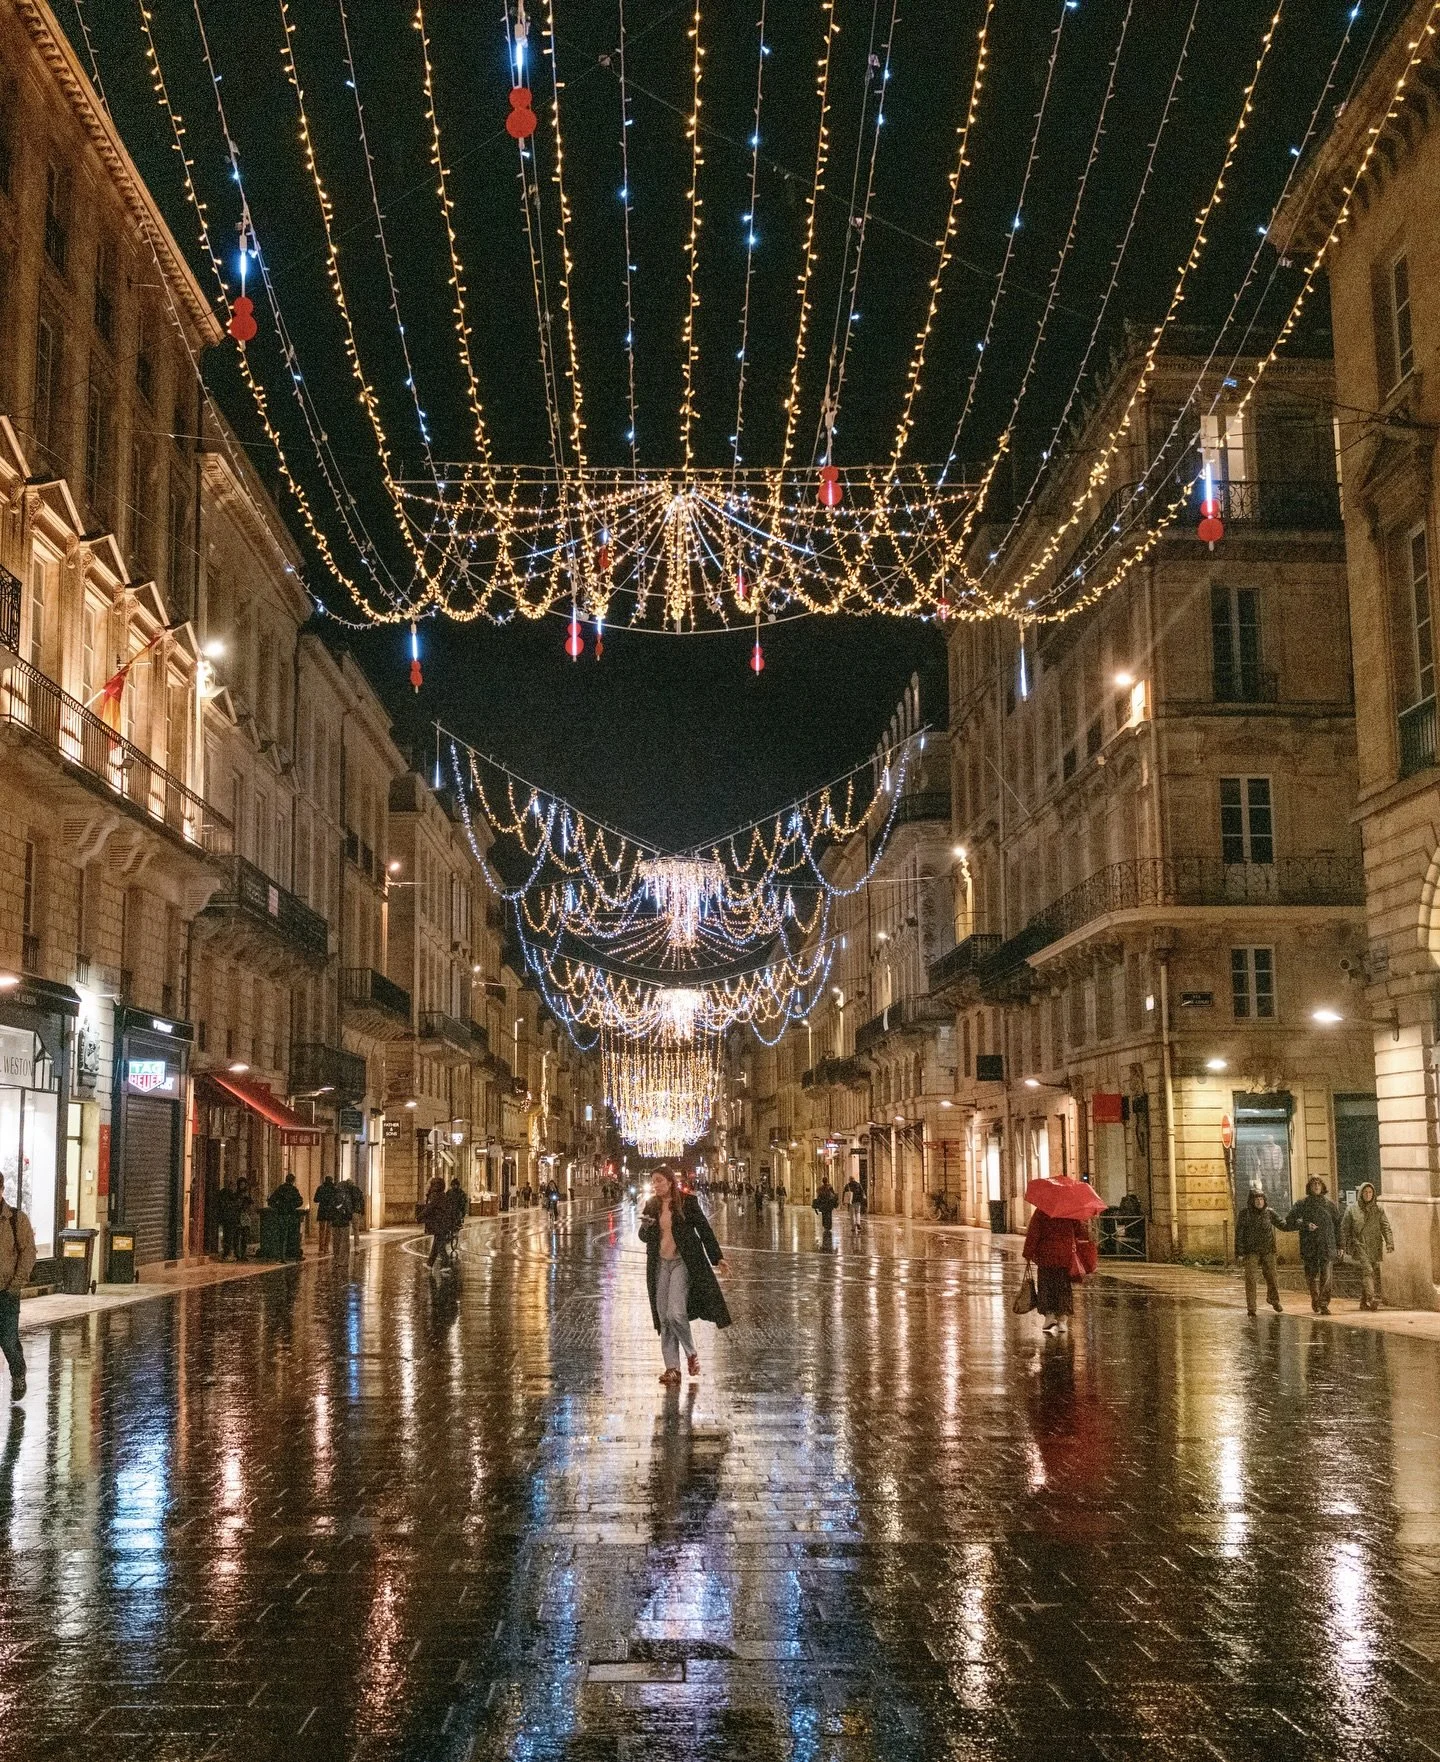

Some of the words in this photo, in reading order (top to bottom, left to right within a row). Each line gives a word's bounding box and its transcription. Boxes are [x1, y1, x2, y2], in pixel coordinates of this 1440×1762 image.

[4, 1056, 33, 1076] WESTON
[131, 1063, 163, 1073] TAG
[131, 1074, 162, 1089] HEUER
